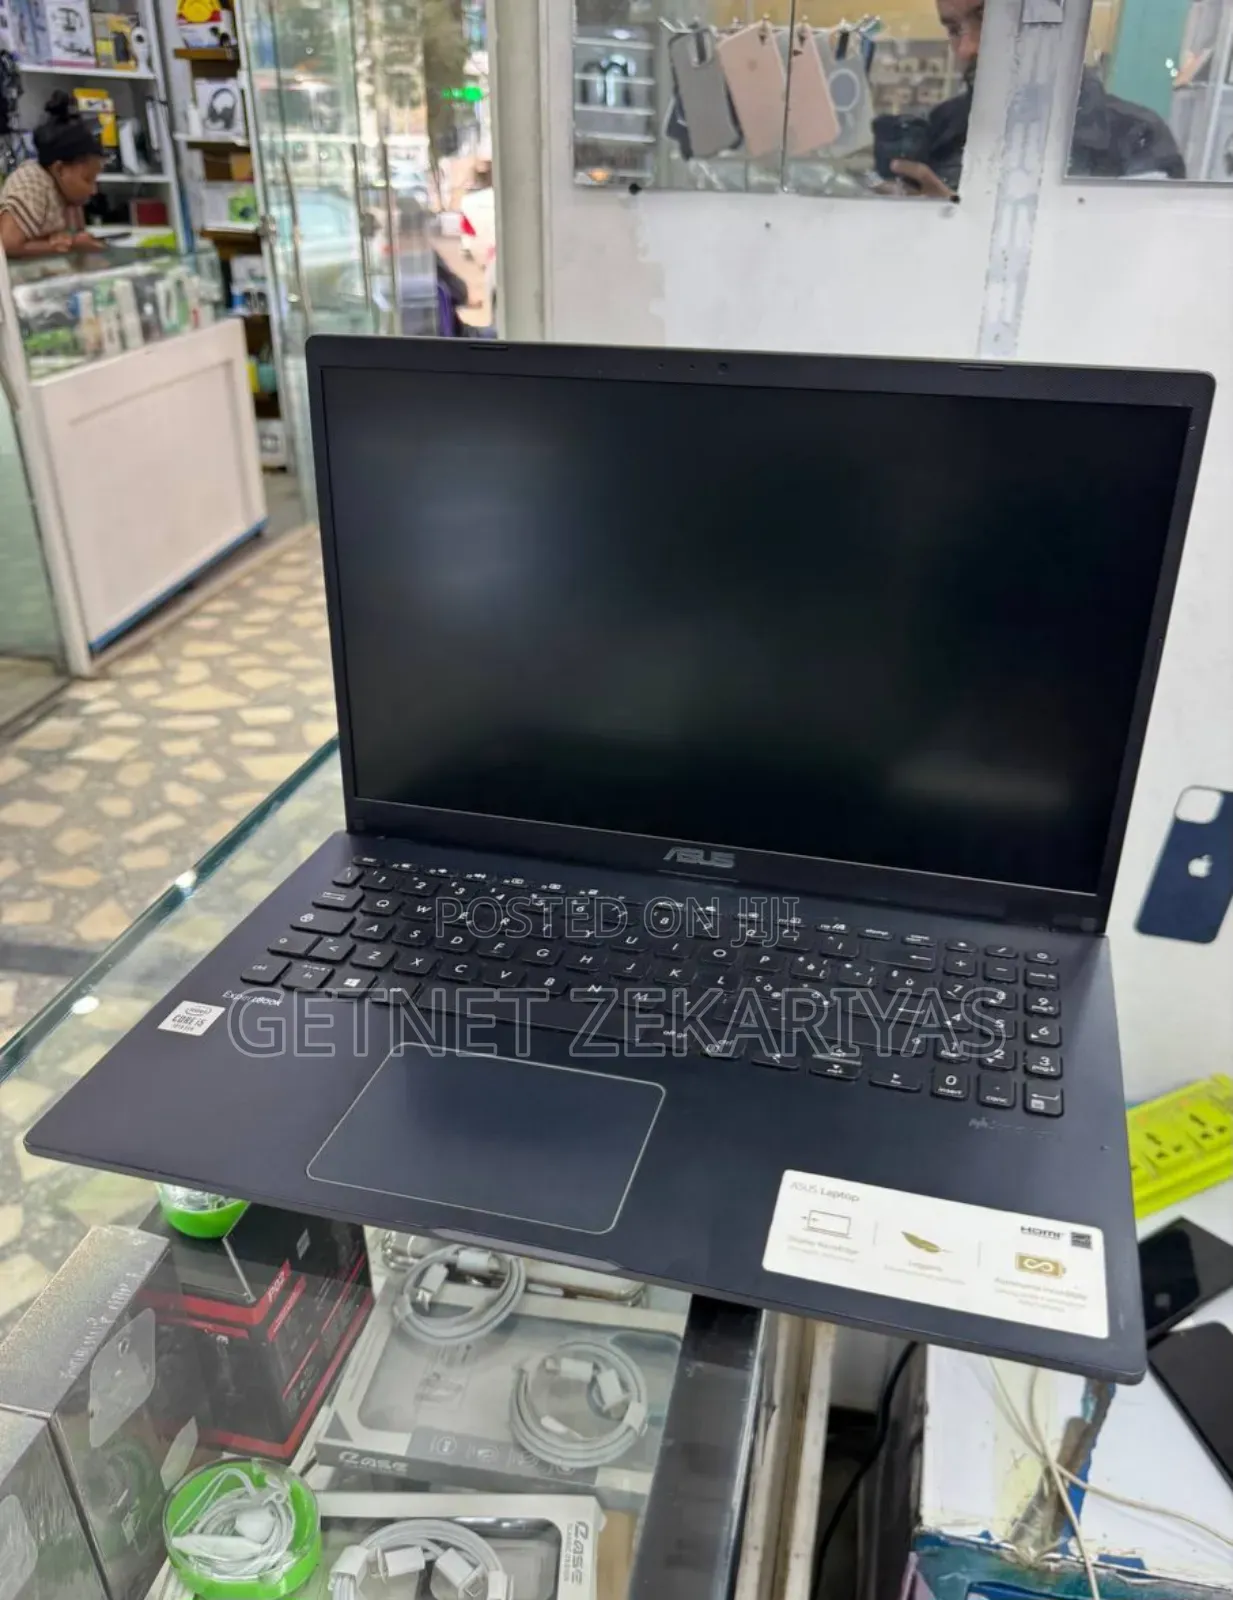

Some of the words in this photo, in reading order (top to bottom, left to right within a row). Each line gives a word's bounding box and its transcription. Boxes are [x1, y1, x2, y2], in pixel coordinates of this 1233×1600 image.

[663, 847, 736, 869] ASUS
[790, 1182, 817, 1193] ASUS
[820, 1187, 860, 1202] Laptop
